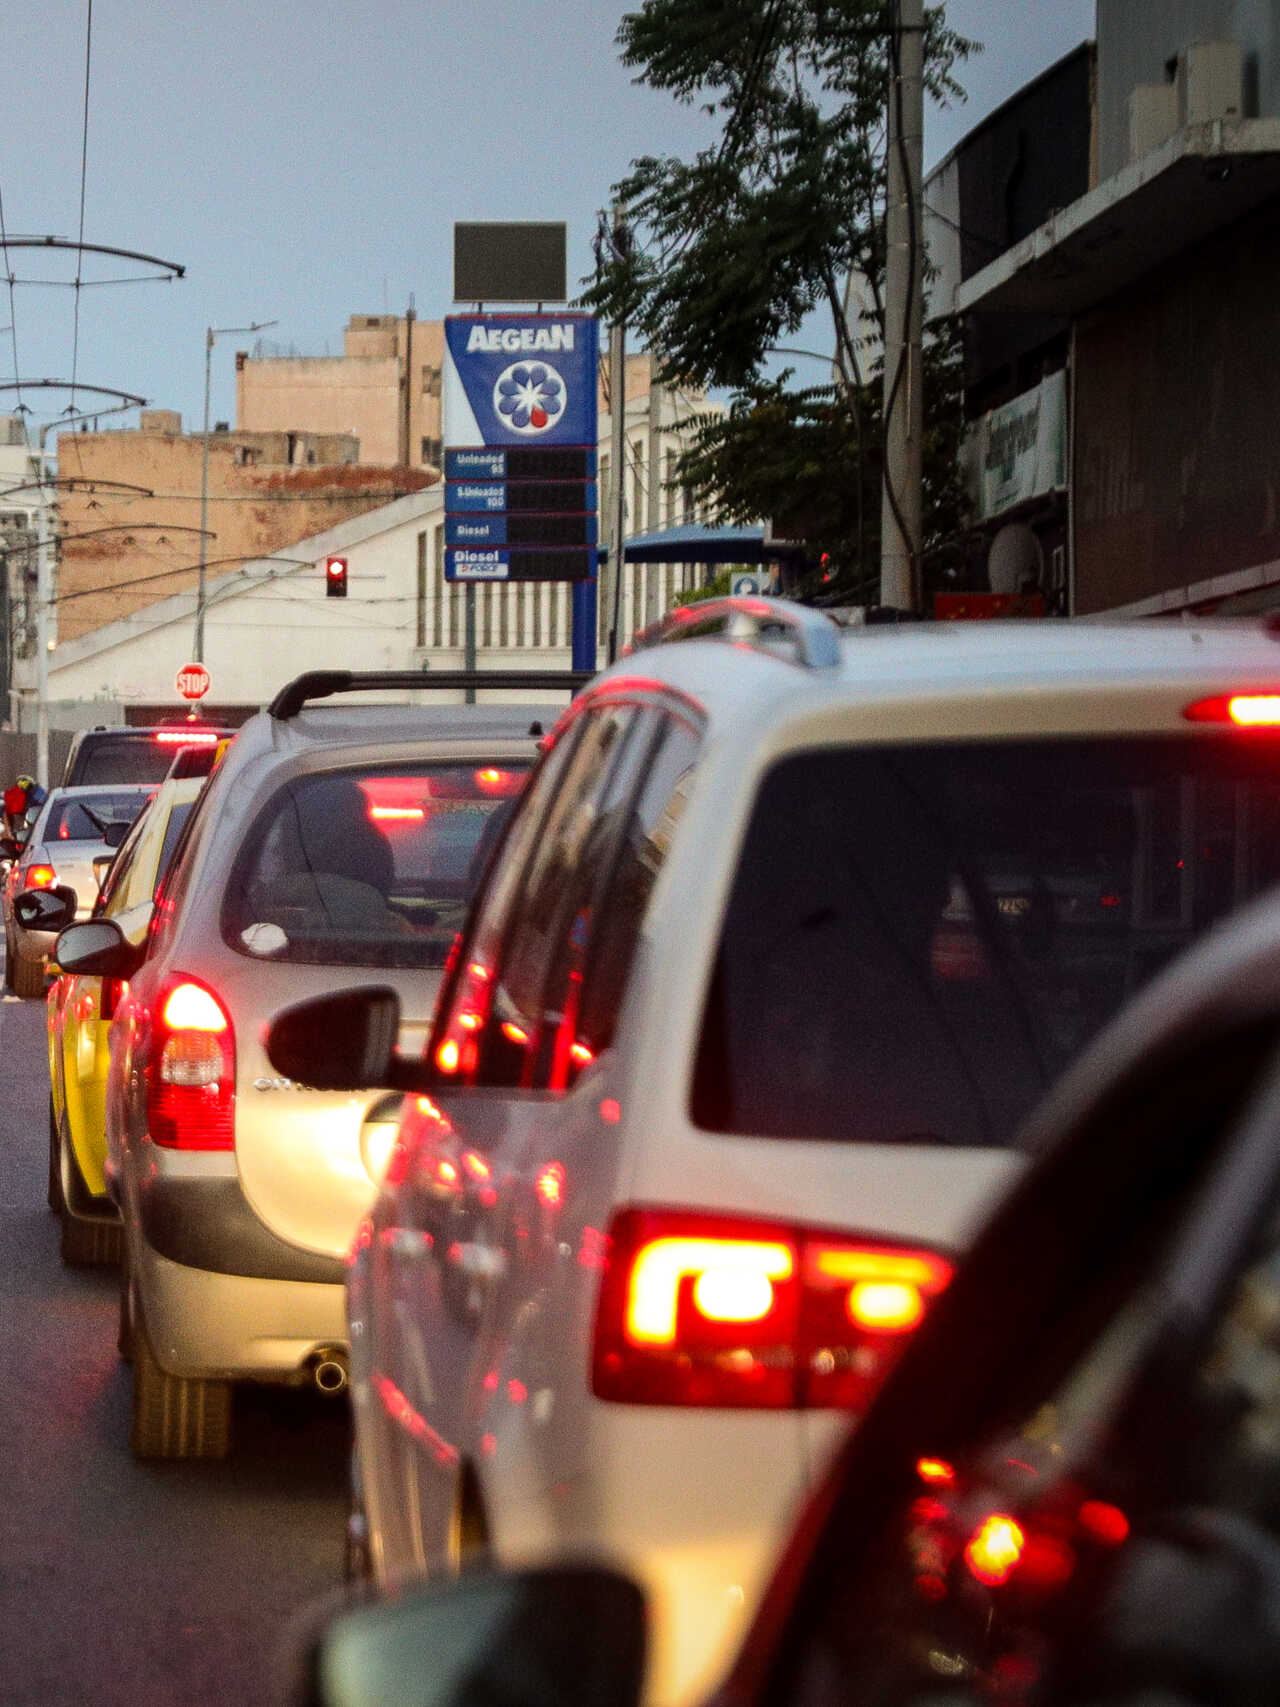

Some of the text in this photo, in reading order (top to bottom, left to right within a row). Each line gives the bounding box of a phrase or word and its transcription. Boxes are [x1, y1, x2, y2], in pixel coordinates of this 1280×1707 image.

[467, 324, 574, 352] AEGEAN
[457, 453, 504, 464] Unleaded
[457, 525, 489, 536] Diesel
[455, 550, 499, 562] Diesel
[178, 674, 208, 692] STOP
